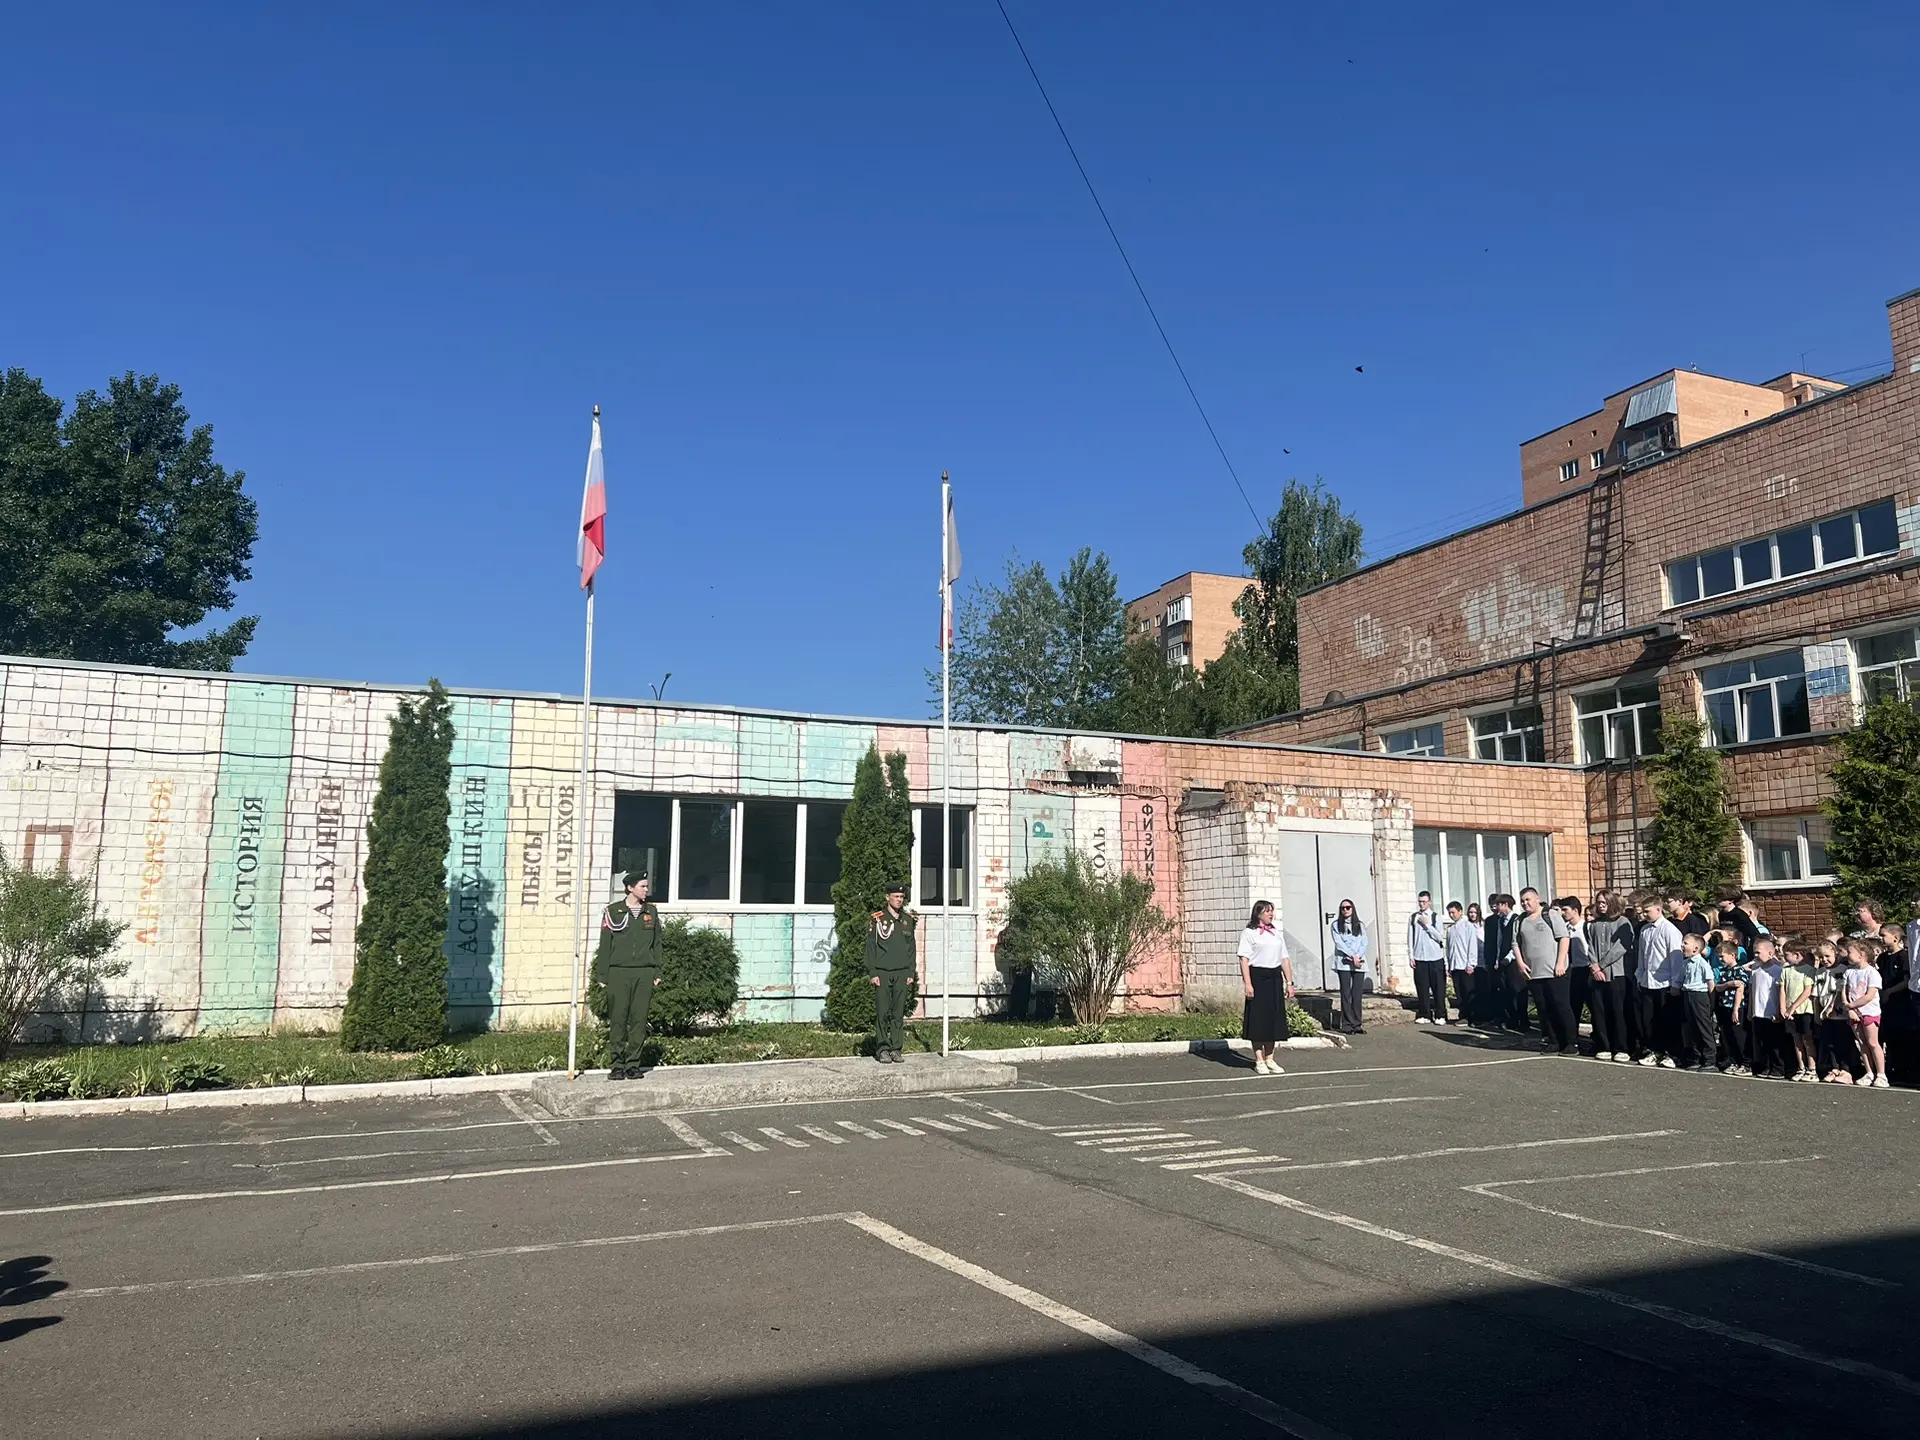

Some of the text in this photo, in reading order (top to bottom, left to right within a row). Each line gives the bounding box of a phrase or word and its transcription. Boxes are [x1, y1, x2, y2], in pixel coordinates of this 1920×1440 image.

[231, 795, 263, 934] ИСТОРИЯ
[311, 781, 342, 945] И.А.БУНИН
[521, 831, 543, 907] ПЬЕСЫ
[1093, 826, 1106, 888] ГОЛЬ
